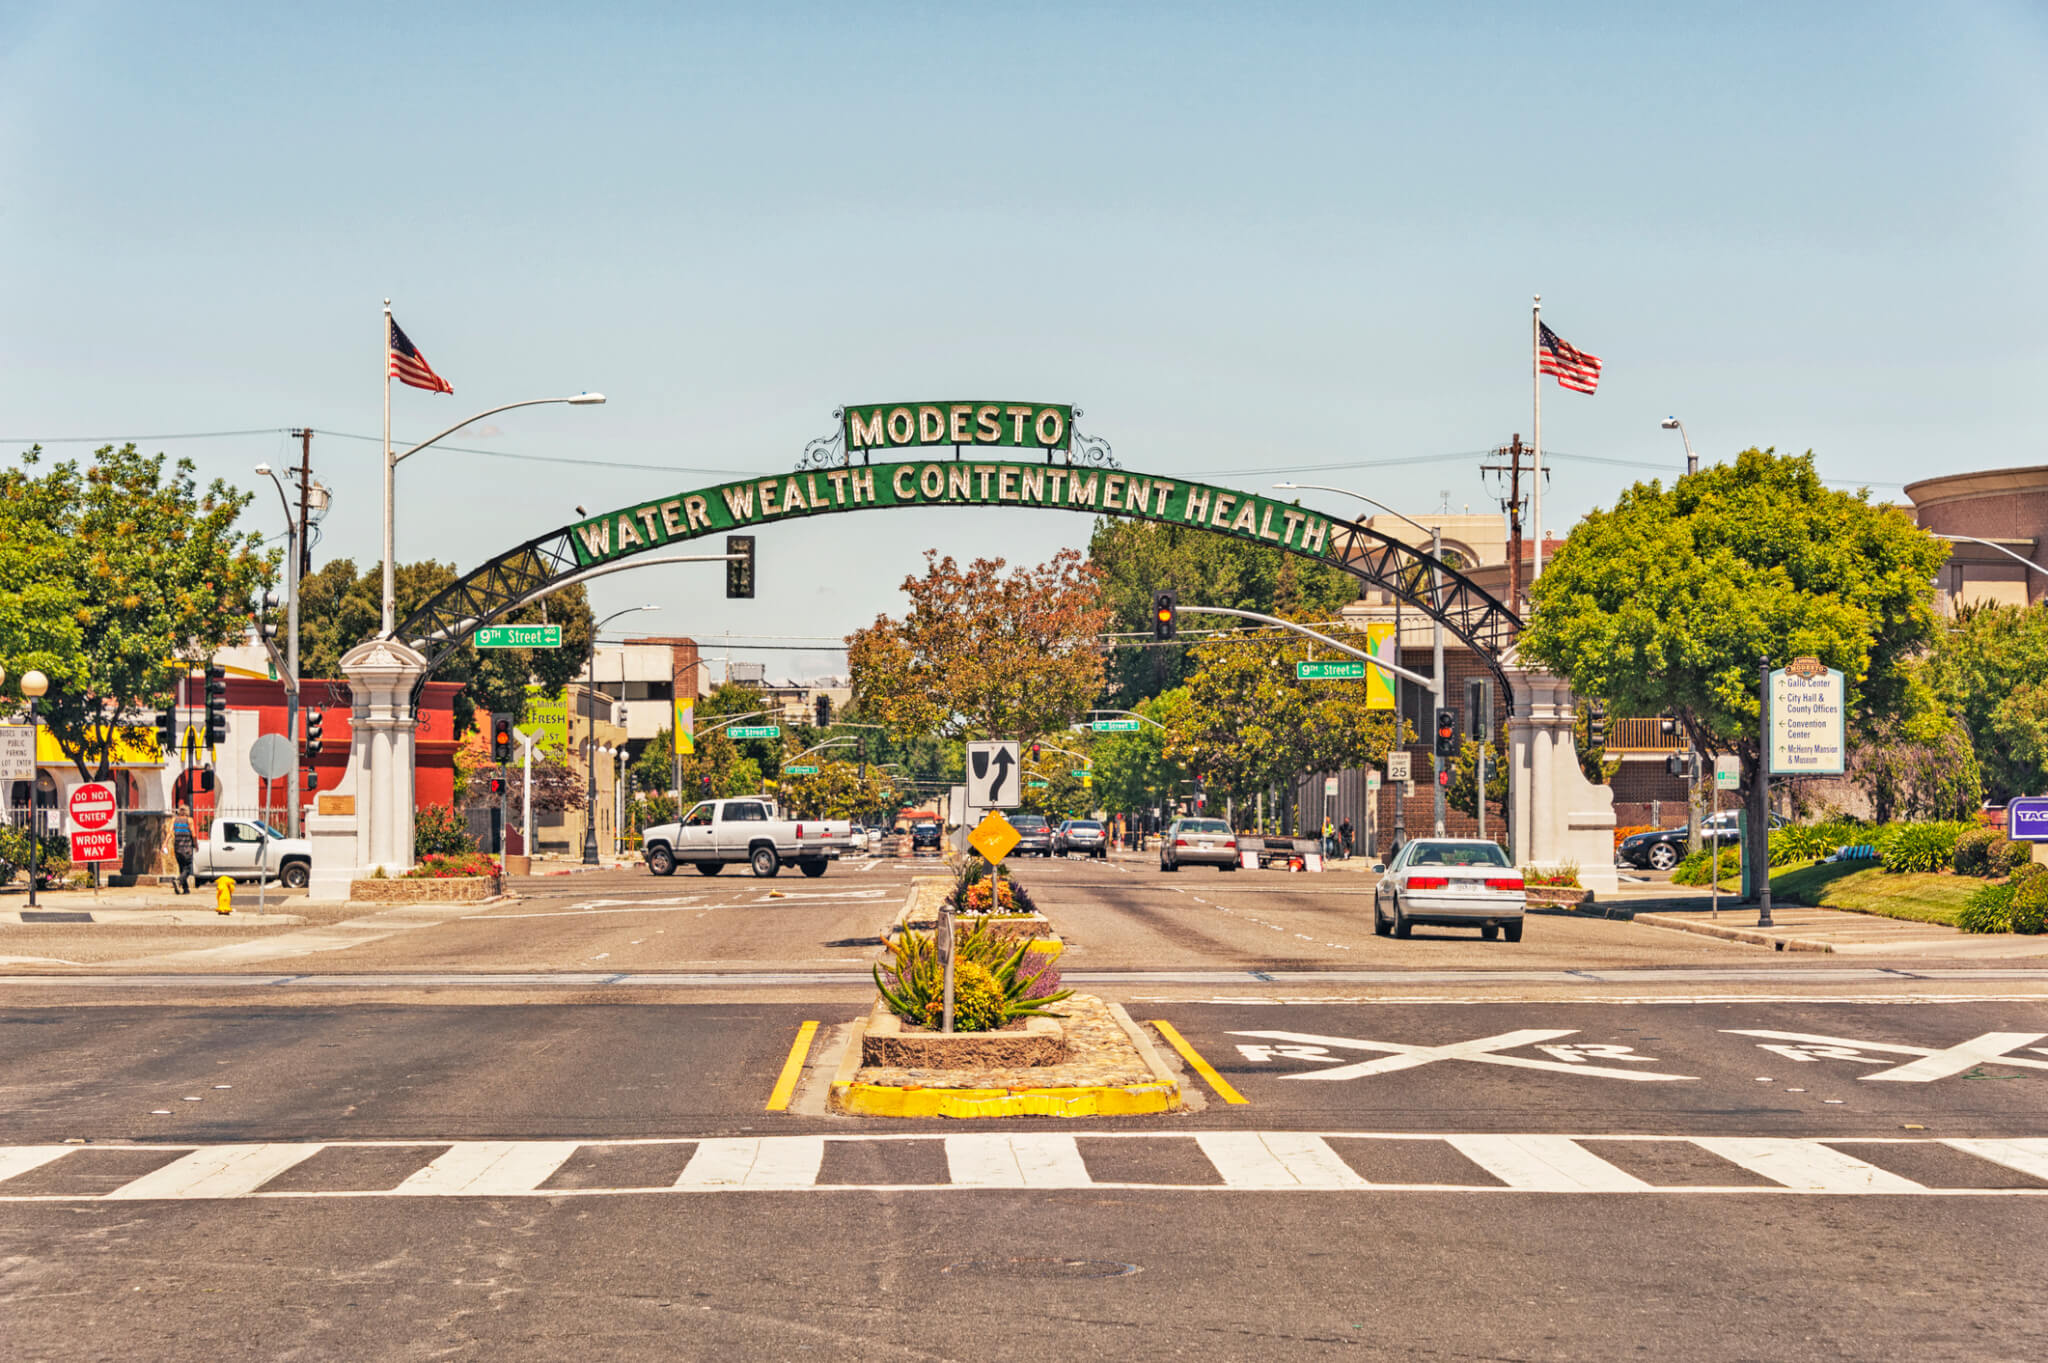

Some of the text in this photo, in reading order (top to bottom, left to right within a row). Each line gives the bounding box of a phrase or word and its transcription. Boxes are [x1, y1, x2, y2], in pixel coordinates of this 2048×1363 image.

[851, 405, 1064, 447] MODESTO
[578, 464, 1329, 558] WATER WEALTH CONTENTMENT HEALTH
[480, 630, 501, 644] 9TH
[508, 630, 542, 643] Street
[1302, 665, 1349, 676] 9TH Street
[1787, 678, 1831, 688] Gallo Center
[1787, 693, 1824, 704] City Hall &
[1787, 703, 1838, 715] County Offices
[1787, 719, 1826, 728] Convention
[1787, 730, 1811, 739] Center
[1787, 744, 1838, 755] McHenry Mansion
[1391, 767, 1407, 778] 25
[75, 791, 108, 802] DO NOT
[79, 812, 106, 823] ENTER
[76, 834, 112, 846] WRONG
[83, 846, 105, 857] WAY
